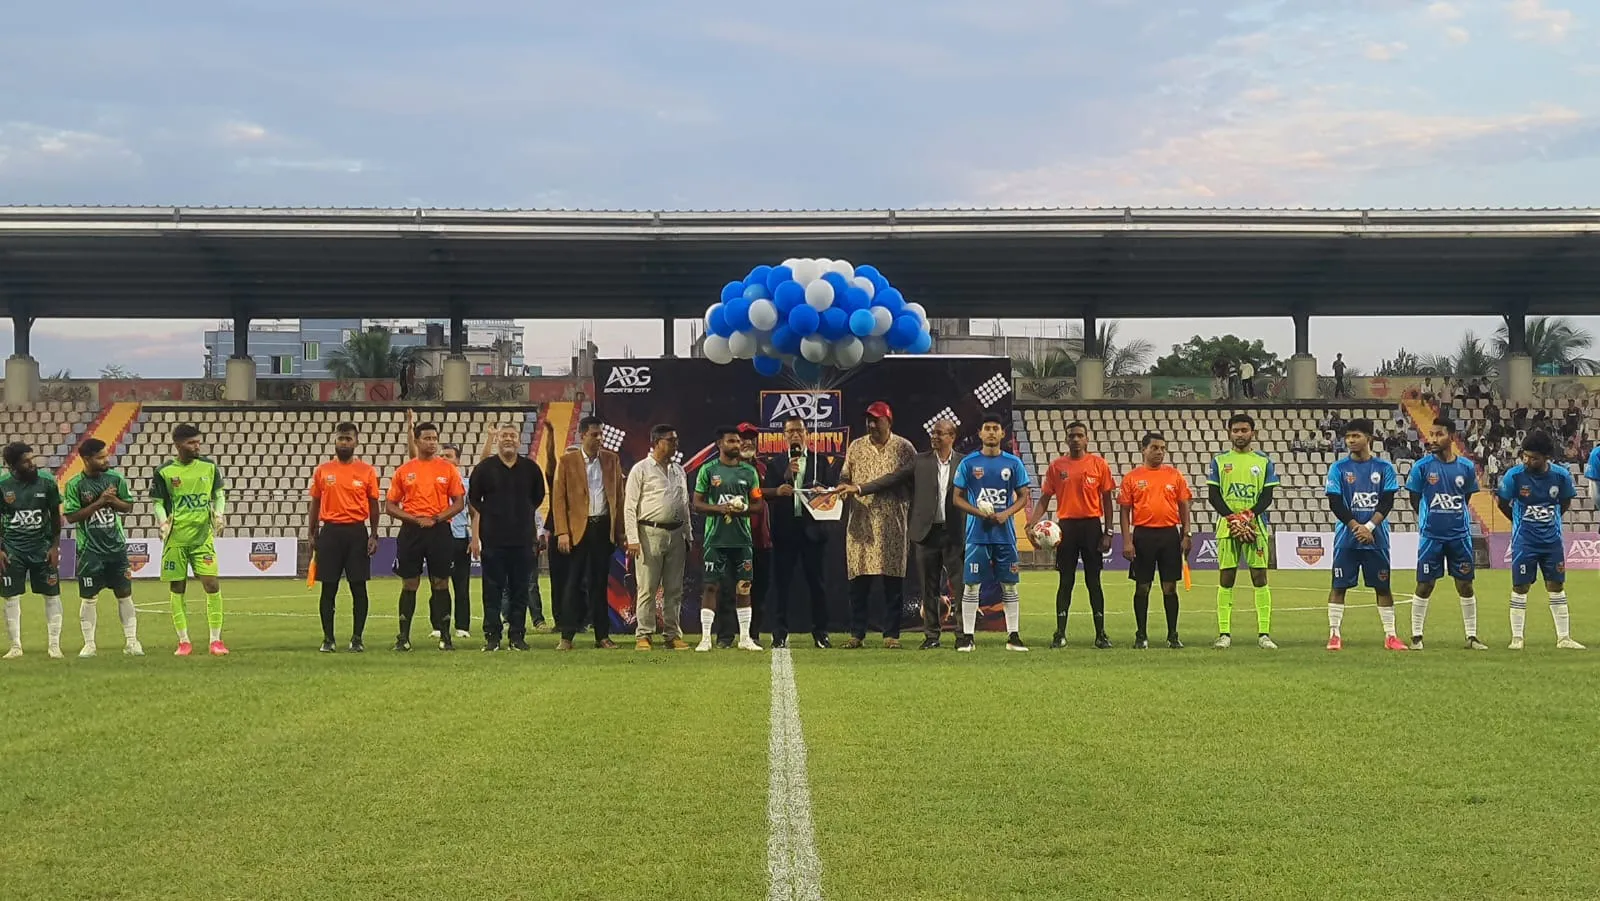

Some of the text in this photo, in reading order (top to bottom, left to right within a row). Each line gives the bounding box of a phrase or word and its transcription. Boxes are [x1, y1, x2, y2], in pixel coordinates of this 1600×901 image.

[605, 366, 651, 387] ABG
[769, 393, 833, 421] ABG
[977, 488, 1007, 505] ABG
[1226, 483, 1256, 498] ABG
[177, 493, 208, 508] ABG
[1350, 492, 1379, 507] ABG
[1430, 493, 1463, 510] ABG
[9, 509, 42, 525] ABG
[704, 561, 714, 572] 77
[1520, 564, 1527, 575] 3
[3, 576, 12, 587] 11
